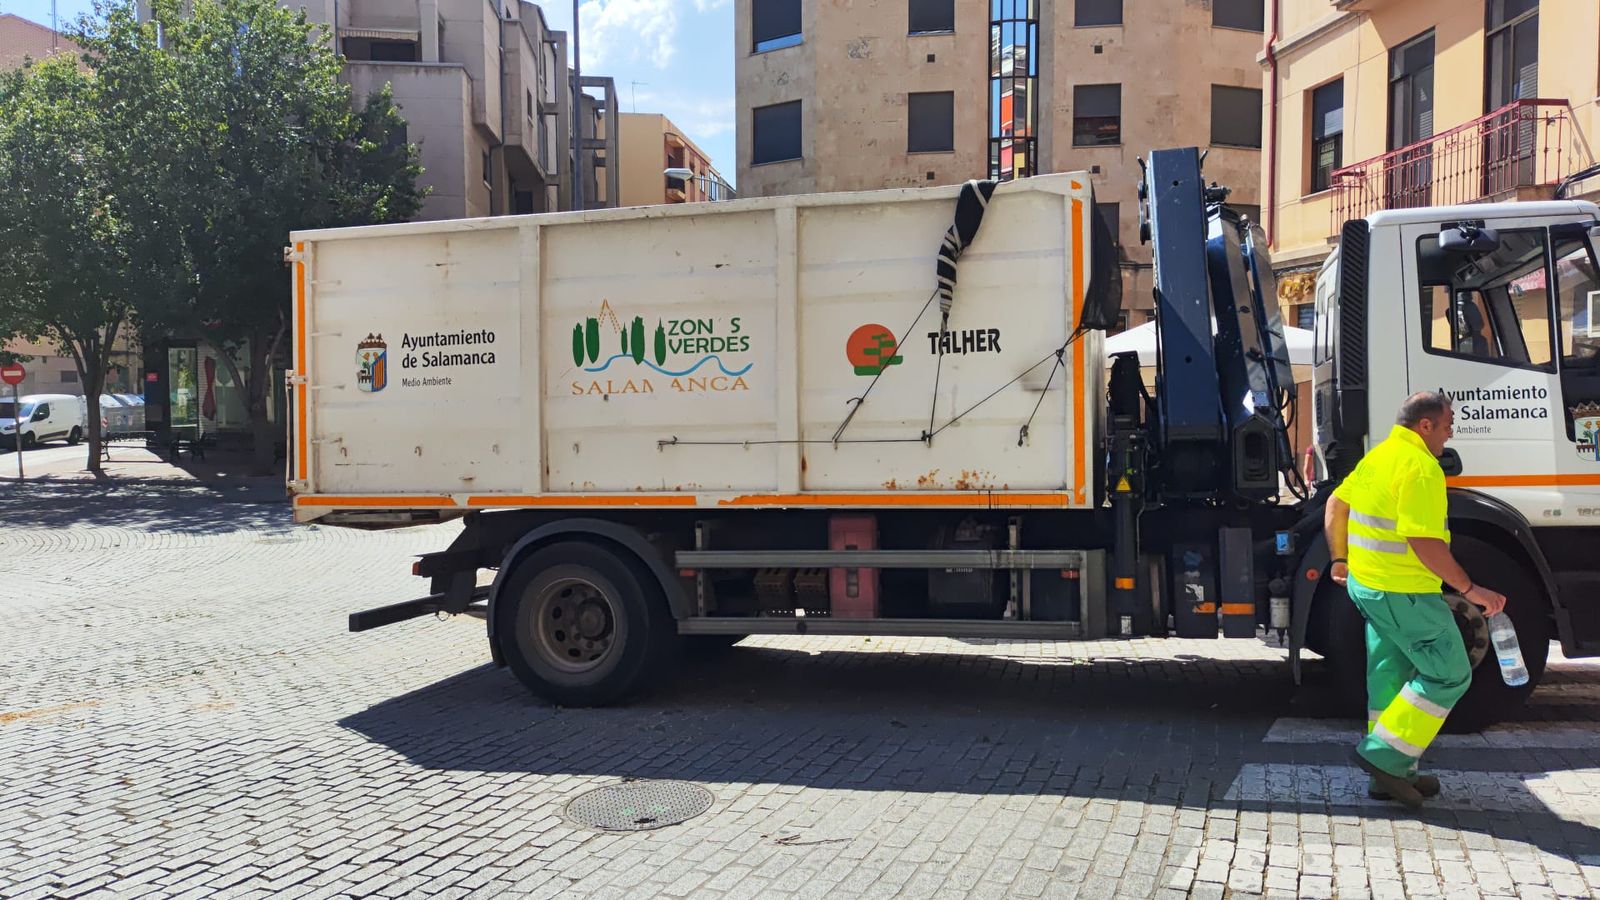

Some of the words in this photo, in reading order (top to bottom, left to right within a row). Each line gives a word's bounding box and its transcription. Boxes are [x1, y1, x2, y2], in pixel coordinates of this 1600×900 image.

[668, 317, 741, 336] ZONS
[401, 329, 496, 351] Ayuntamiento
[668, 336, 750, 354] VERDES
[927, 328, 1002, 356] TALHER
[402, 353, 418, 369] de
[422, 351, 496, 368] Salamanca
[401, 377, 421, 387] Medio
[422, 376, 452, 387] Ambiente
[1461, 405, 1548, 421] Salamanca
[1456, 425, 1492, 435] Ambiente
